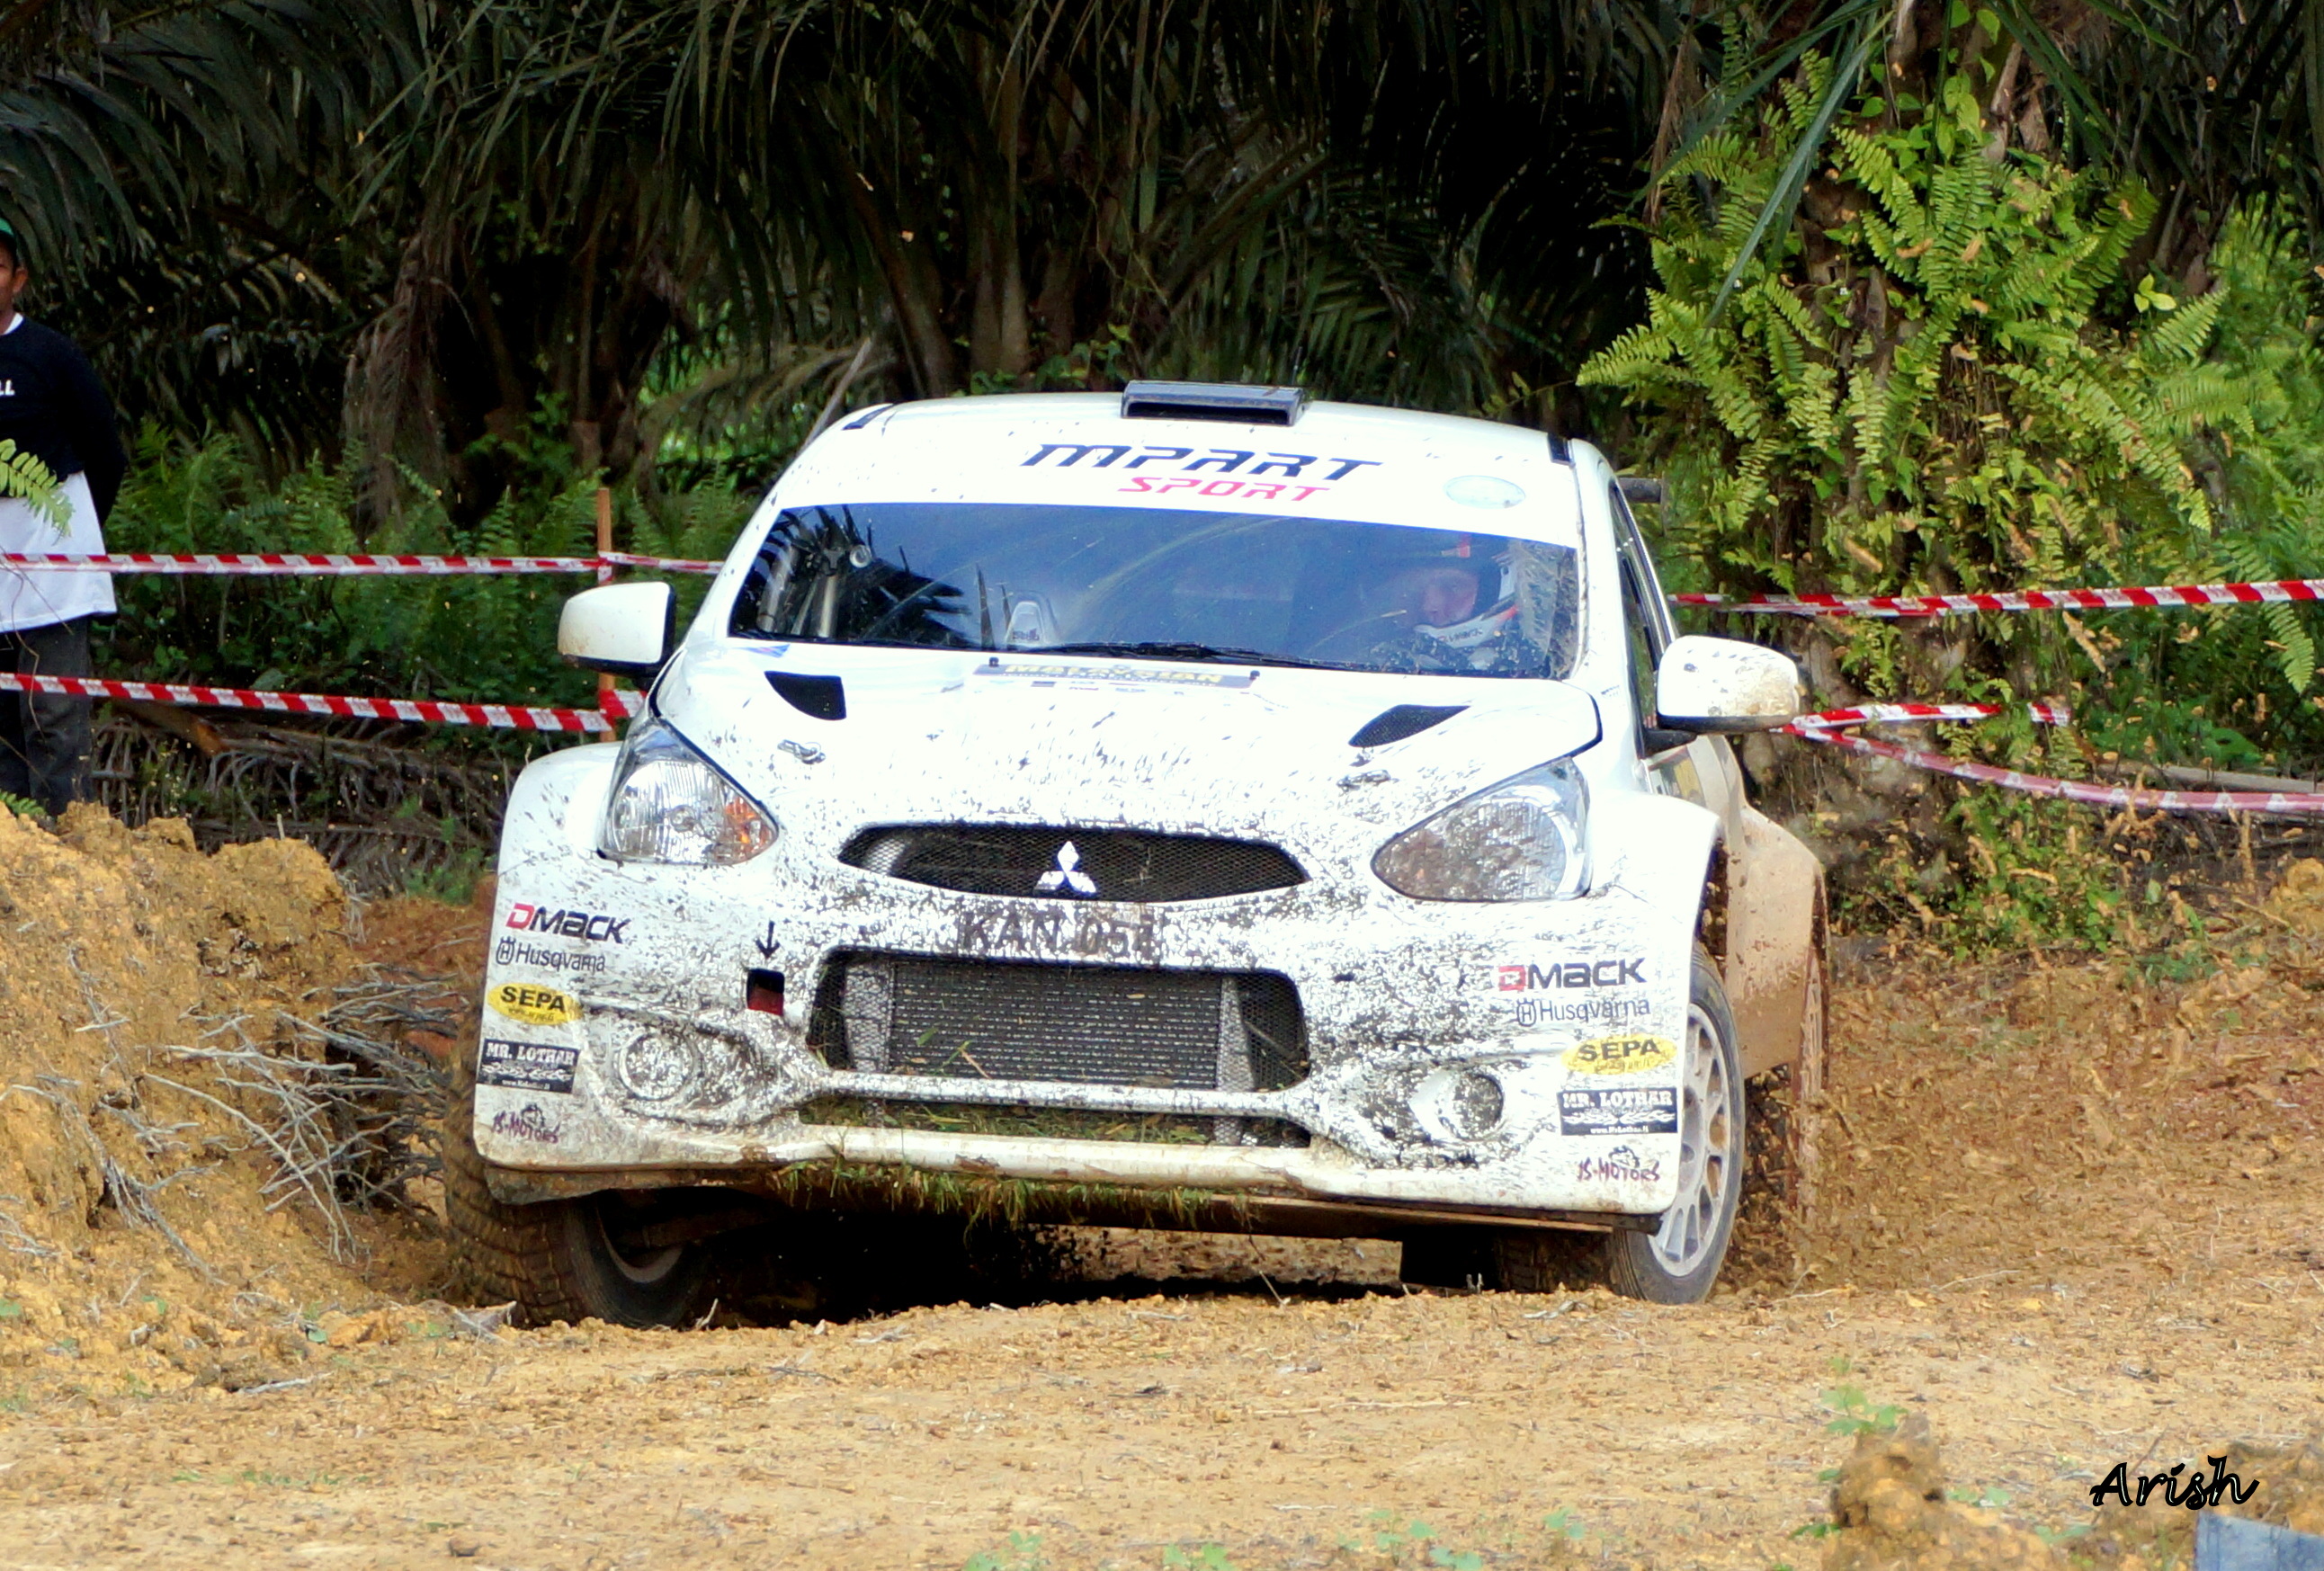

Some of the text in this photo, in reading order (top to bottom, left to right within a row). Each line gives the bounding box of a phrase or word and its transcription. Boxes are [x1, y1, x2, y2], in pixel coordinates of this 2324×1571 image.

[1020, 443, 1383, 481] MPART
[1118, 476, 1330, 502] SPORT
[515, 942, 606, 974] Husqvarna
[500, 986, 567, 1013] SEPA
[1539, 998, 1651, 1023] Husqvarna
[486, 1042, 513, 1059] MR.
[516, 1046, 576, 1066] LOTHAR
[1578, 1039, 1661, 1062] SEPA
[1562, 1091, 1673, 1109] MR. LOTHAR
